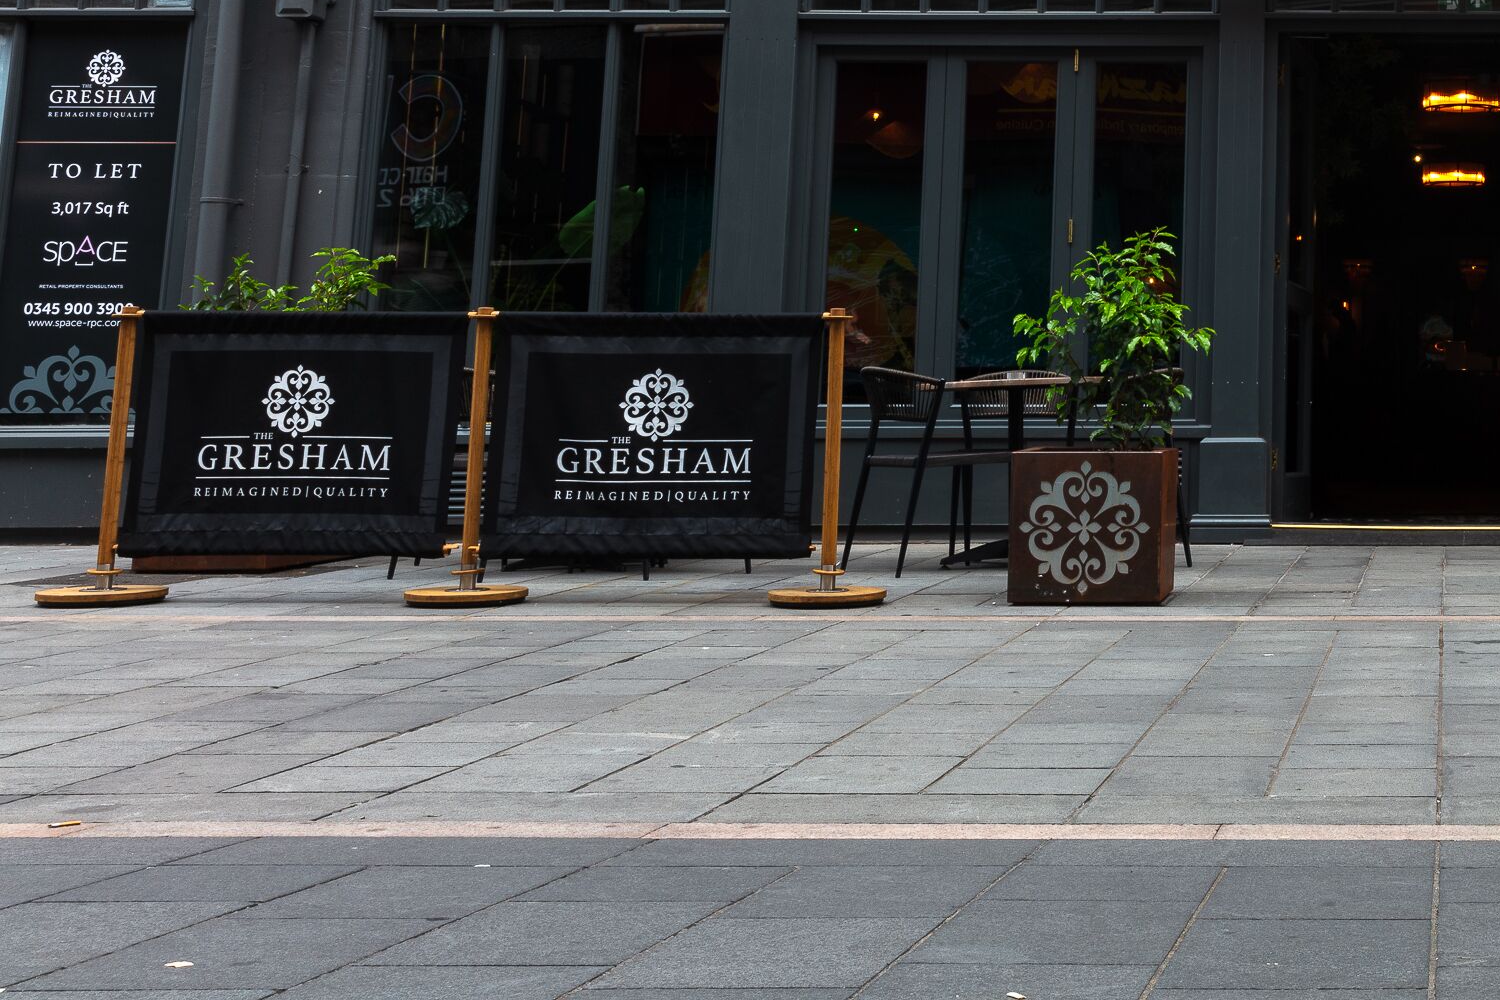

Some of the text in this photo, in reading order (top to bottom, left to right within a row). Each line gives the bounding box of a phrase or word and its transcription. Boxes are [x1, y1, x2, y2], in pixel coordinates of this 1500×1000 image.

[49, 89, 157, 105] GRESHAM
[48, 163, 142, 179] TO LET
[51, 201, 130, 218] 3,017 Sq ft
[23, 302, 61, 316] 0345
[64, 302, 93, 316] 900
[253, 432, 274, 440] THE
[611, 436, 632, 445] THE
[197, 443, 392, 472] GRESHAM
[556, 446, 752, 475] GRESHAM
